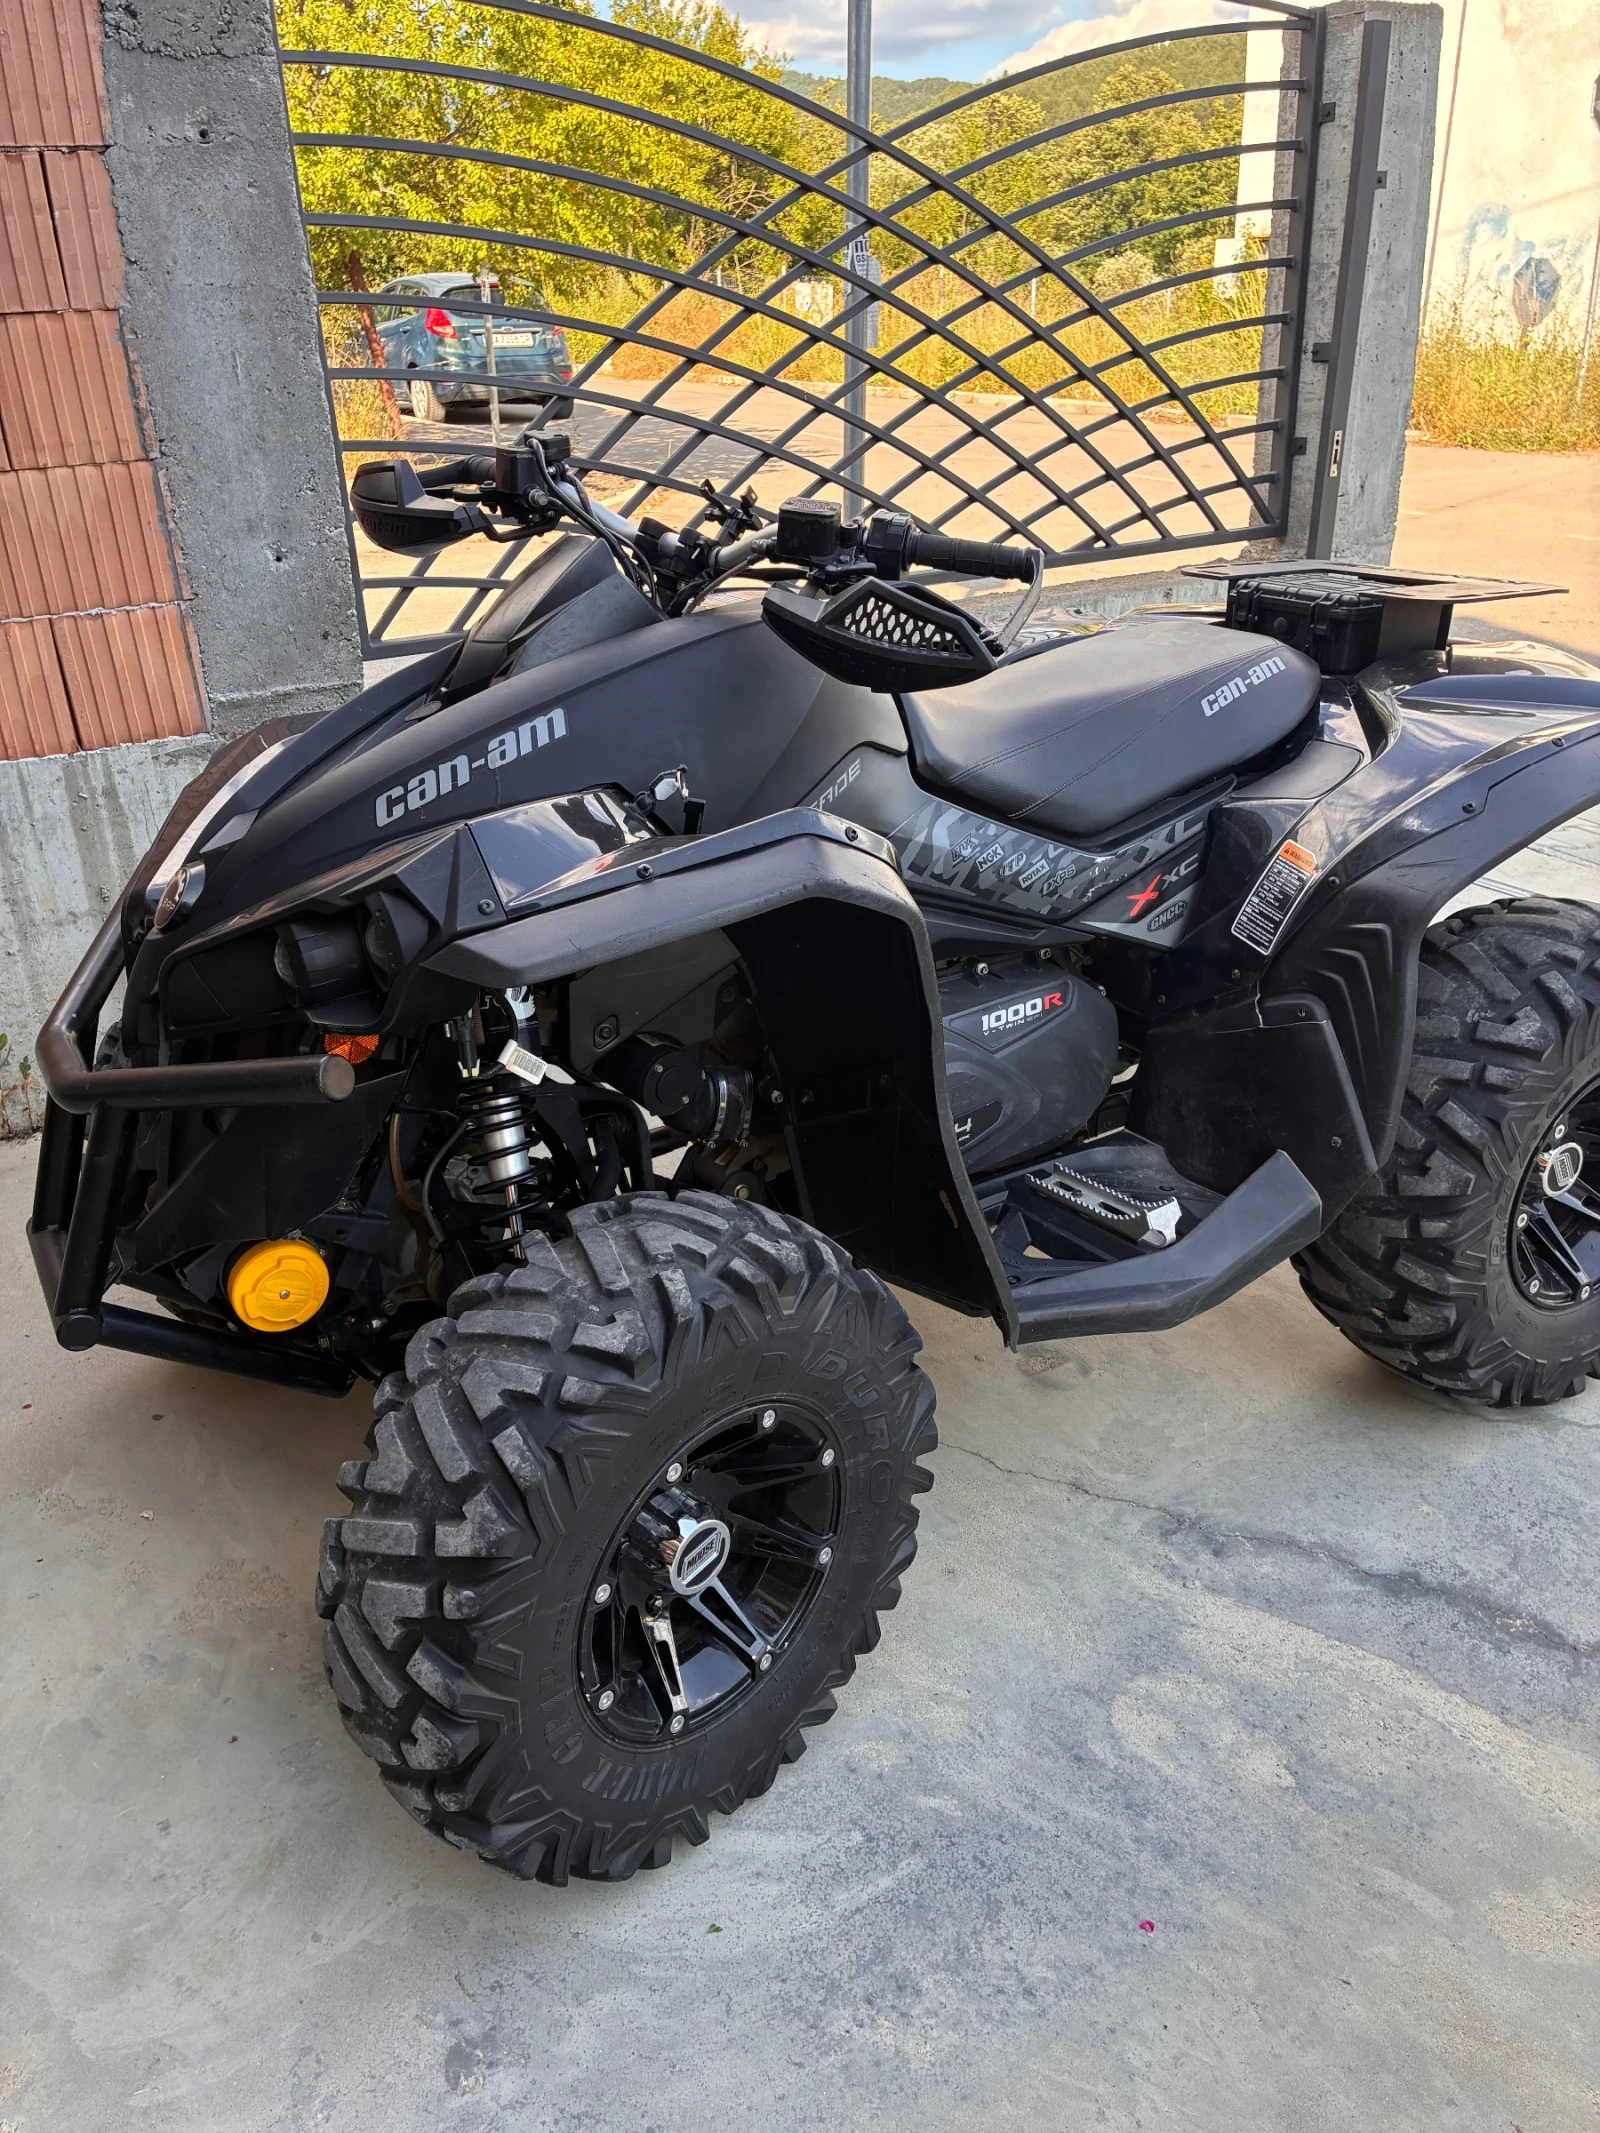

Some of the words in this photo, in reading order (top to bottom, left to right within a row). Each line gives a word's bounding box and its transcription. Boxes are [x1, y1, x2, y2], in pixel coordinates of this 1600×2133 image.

[1200, 656, 1286, 717] can-am
[375, 707, 566, 827] can-am
[979, 846, 1002, 870] NGK
[1021, 863, 1047, 885] ROTAX
[1289, 849, 1313, 868] WARNING
[1150, 901, 1184, 930] GNCC
[983, 1018, 1025, 1036] V-TWIN
[804, 1348, 893, 1503] DURO
[687, 1537, 716, 1572] MOOSE
[538, 1666, 585, 1765] GRIP
[581, 1746, 705, 1802] POWER
